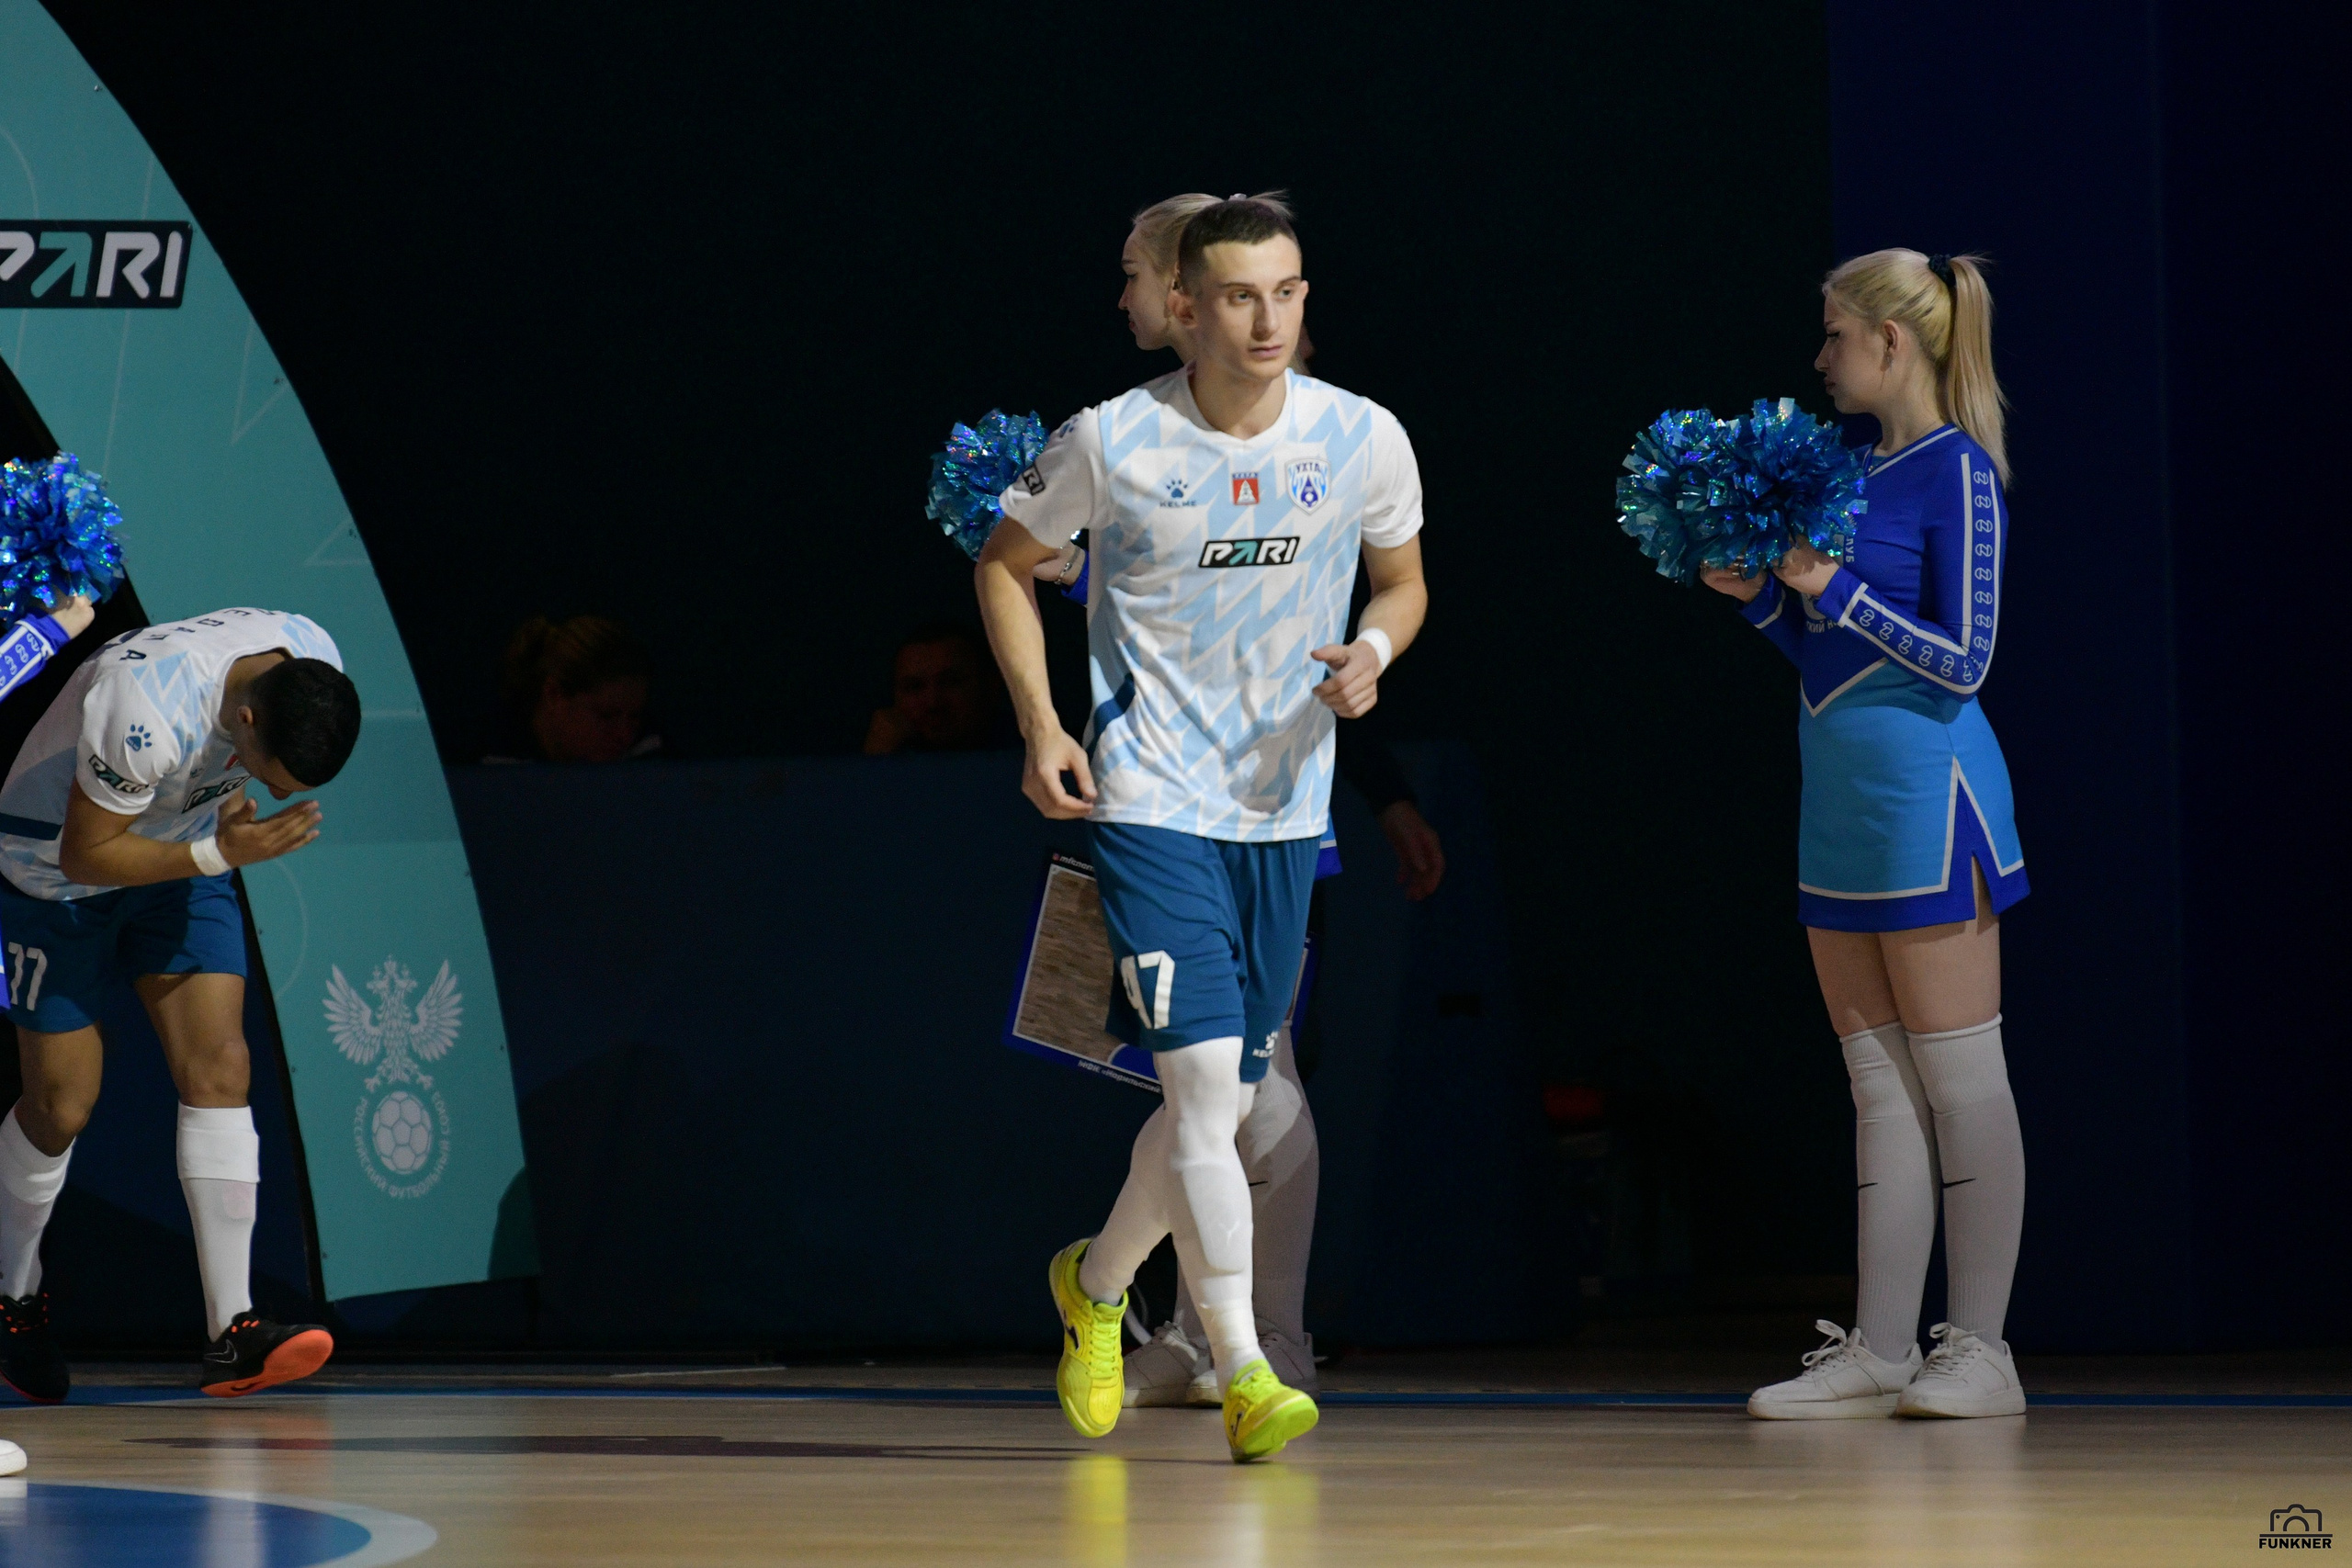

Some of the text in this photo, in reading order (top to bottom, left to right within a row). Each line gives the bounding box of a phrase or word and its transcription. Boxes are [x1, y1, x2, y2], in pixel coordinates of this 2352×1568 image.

[0, 230, 183, 299] PARI
[1159, 500, 1197, 508] KELME
[1201, 537, 1297, 567] PARI
[183, 773, 250, 812] PARI
[7, 941, 48, 1012] 77
